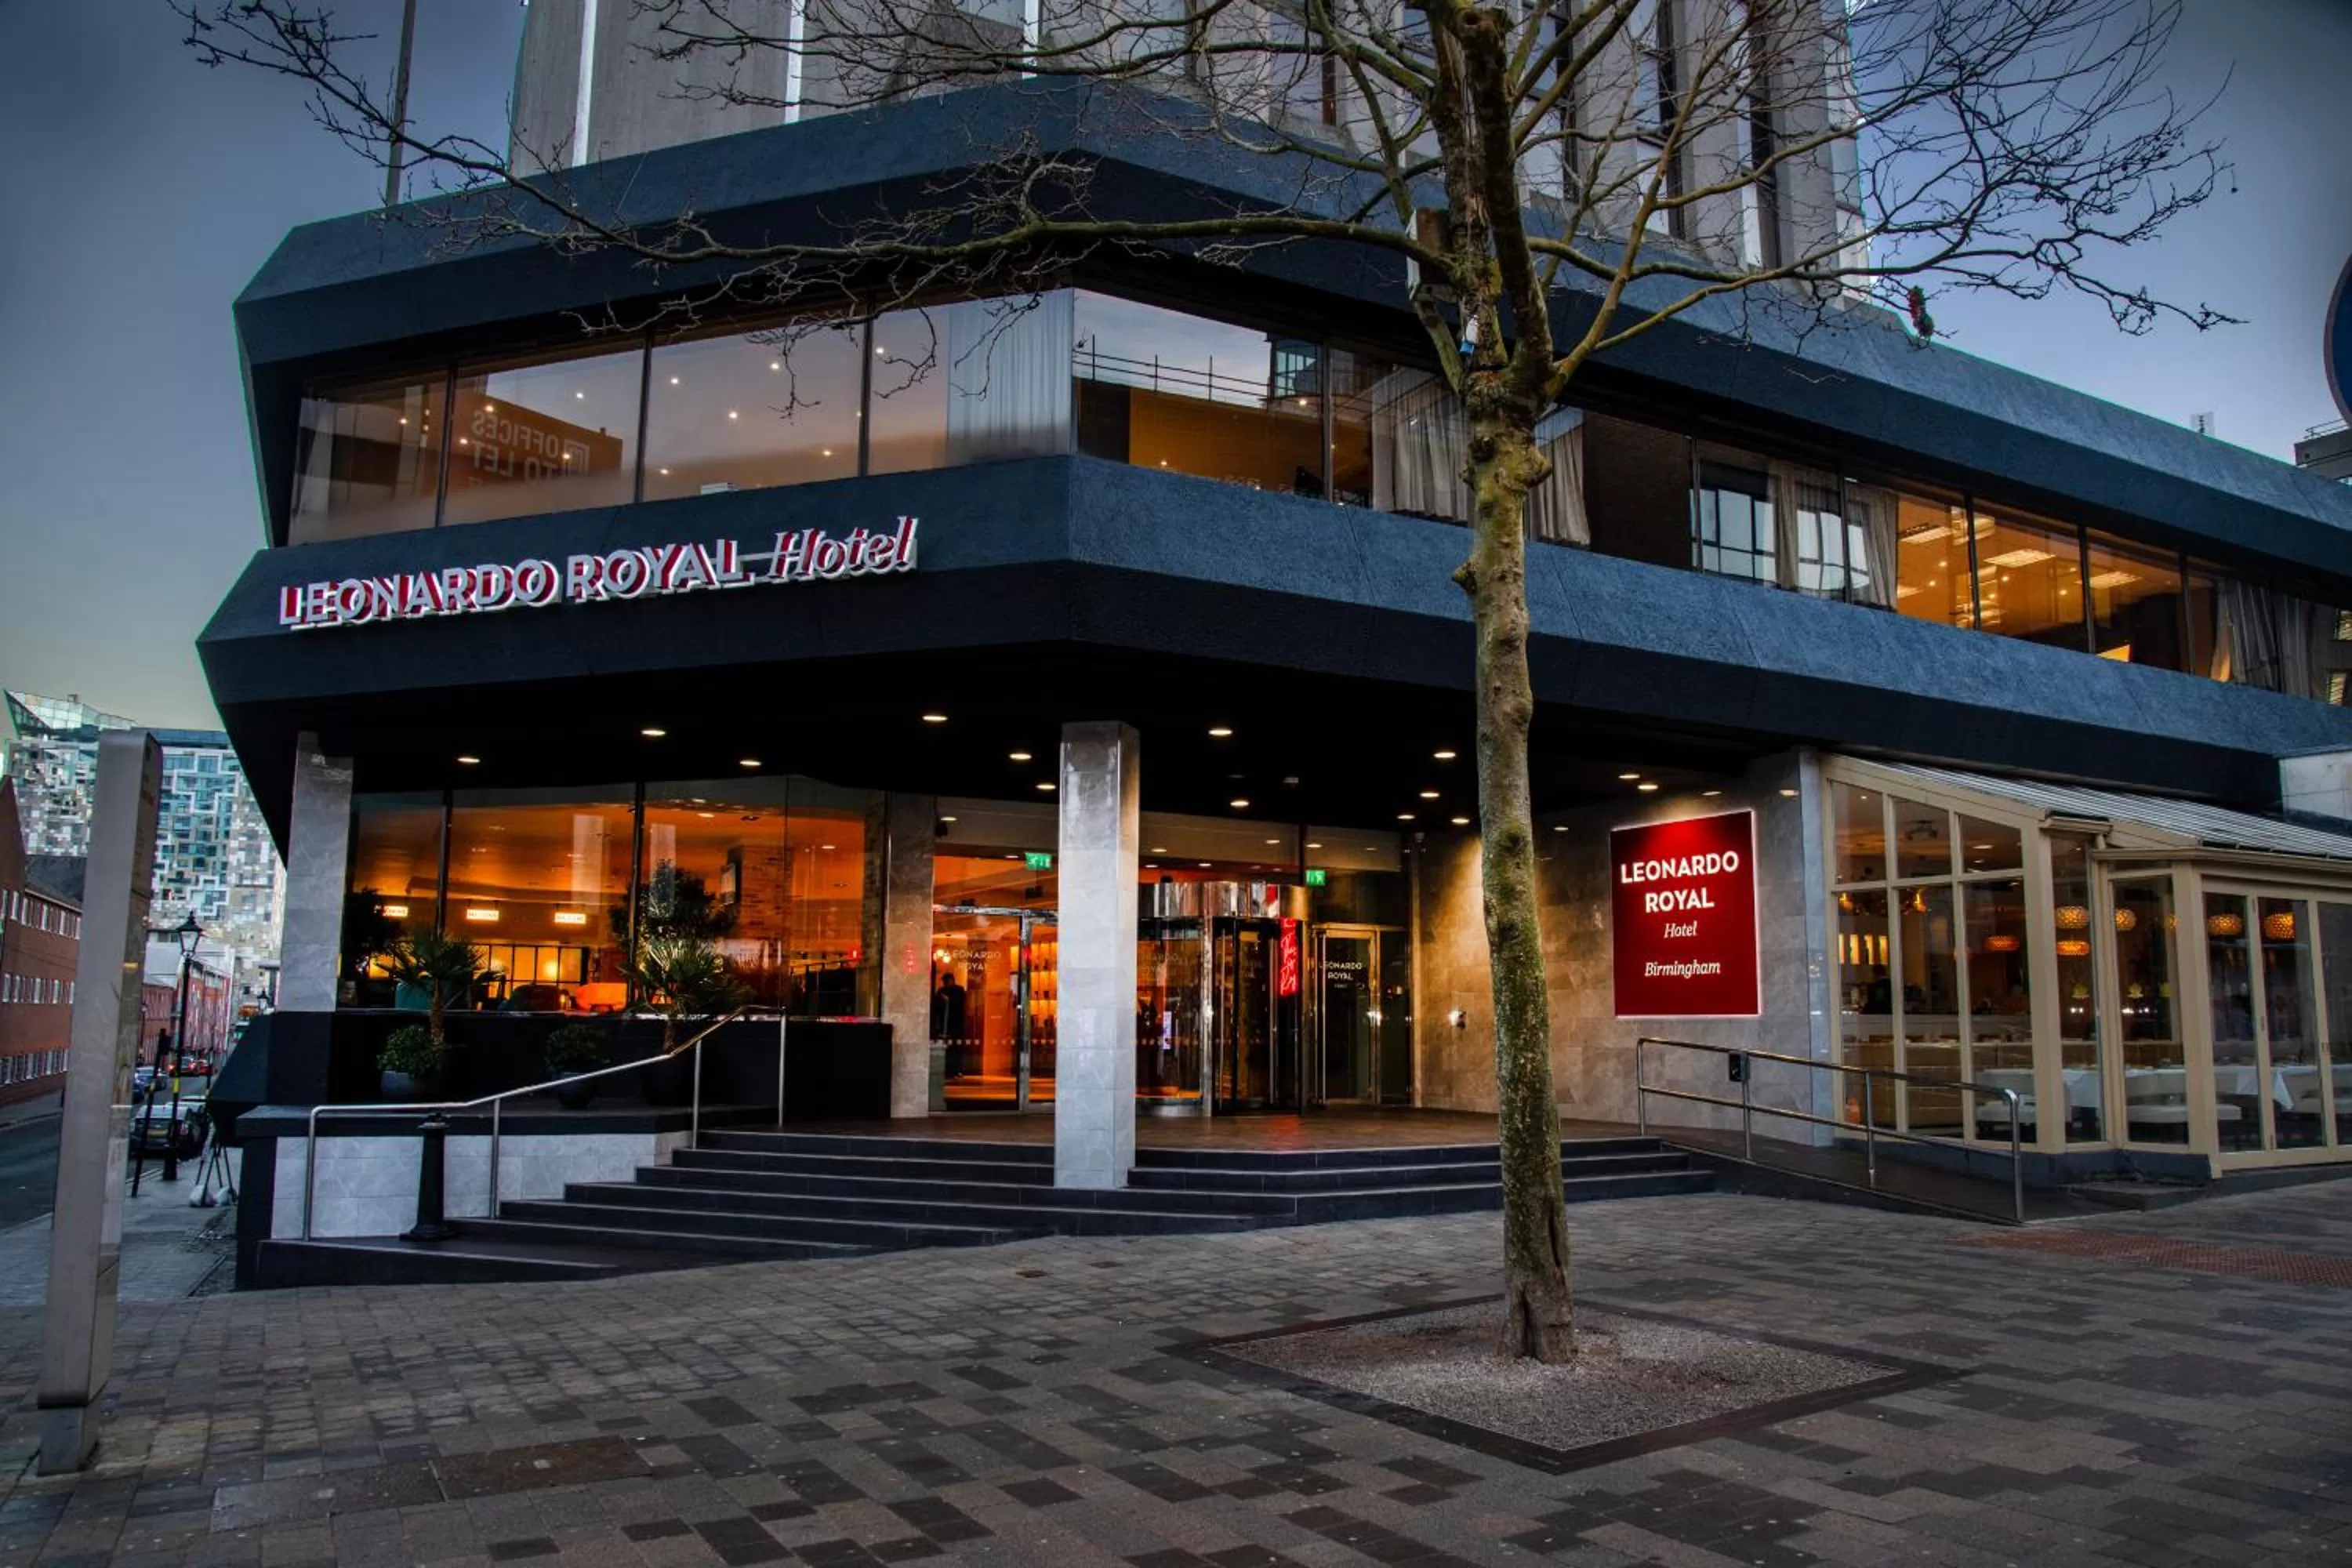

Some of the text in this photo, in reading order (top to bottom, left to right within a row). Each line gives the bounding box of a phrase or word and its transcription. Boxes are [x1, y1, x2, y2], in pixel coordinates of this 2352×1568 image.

[280, 515, 919, 630] LEONARDO ROYAL Hotel
[1621, 851, 1739, 884] LEONARDO
[1645, 887, 1715, 913] ROYAL
[1664, 920, 1697, 938] Hotel
[947, 949, 1001, 960] EONARDO
[1645, 960, 1720, 979] Birmingham
